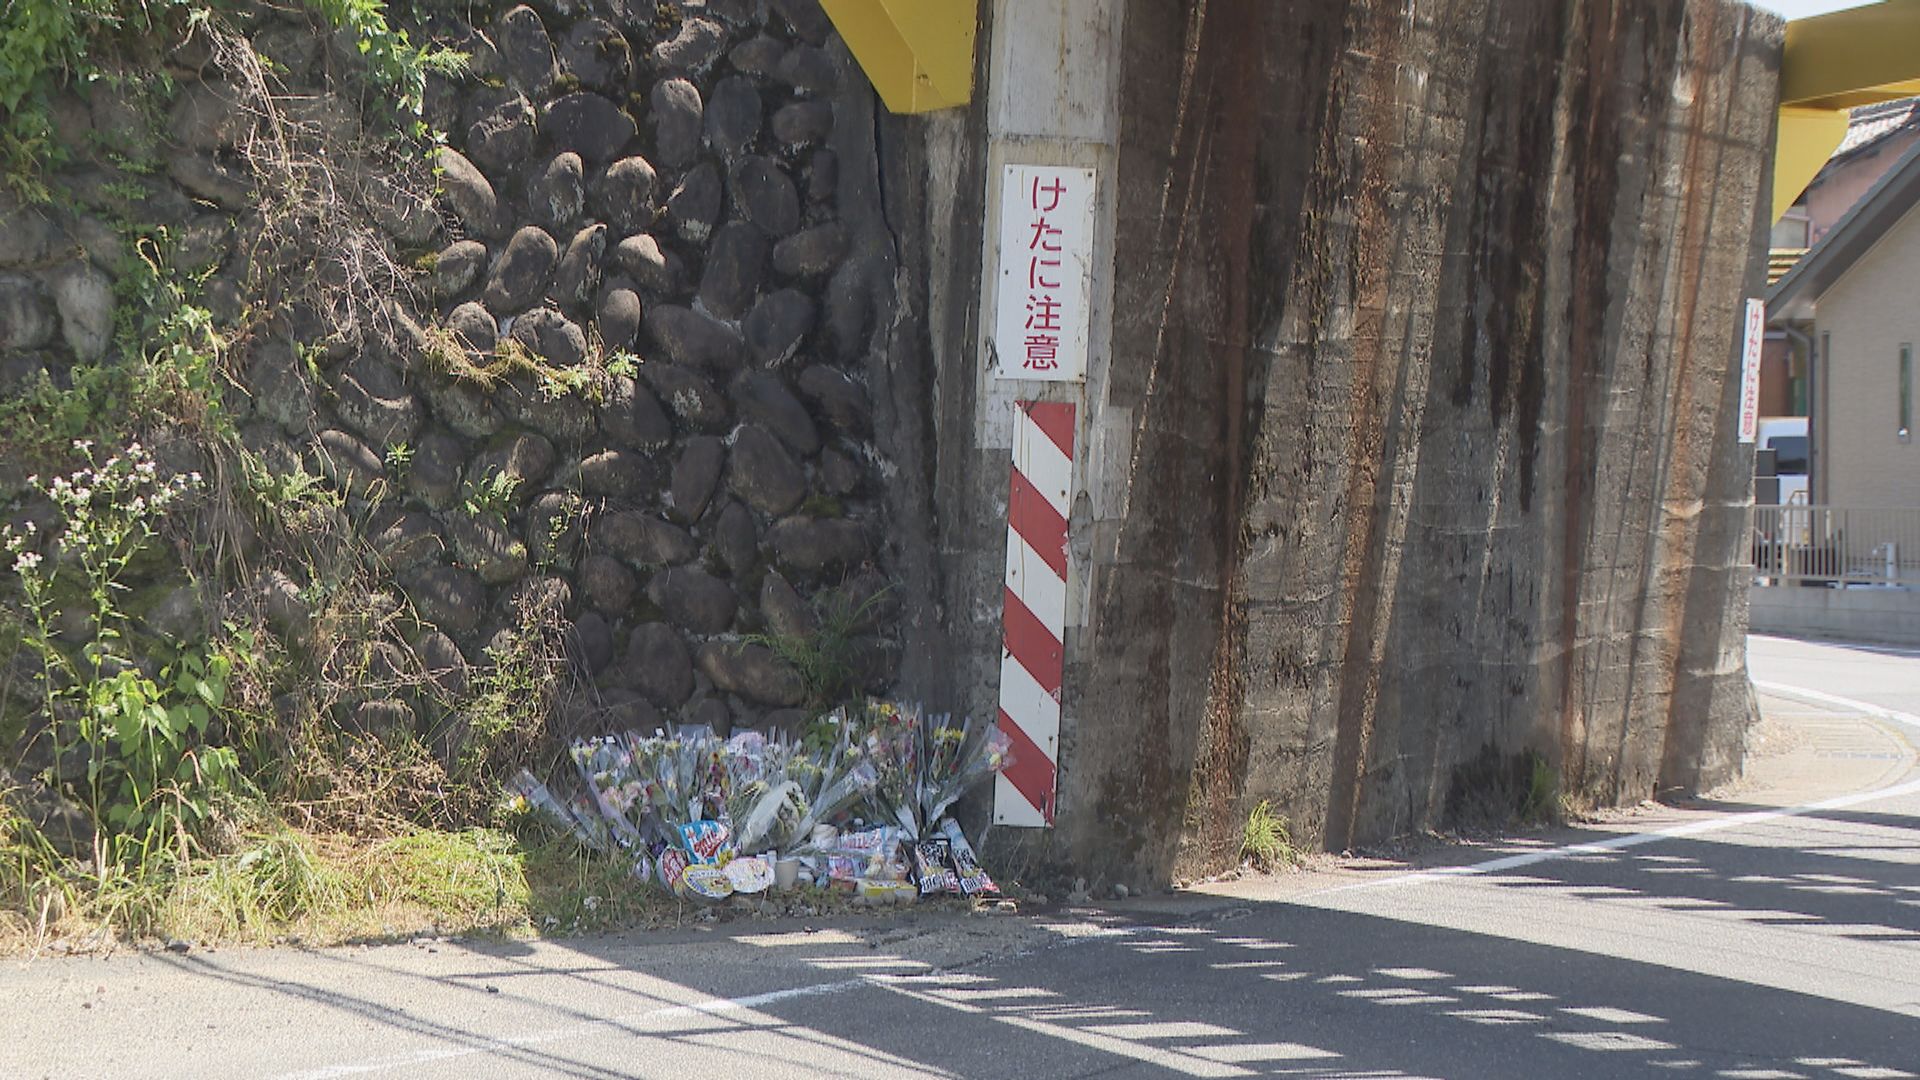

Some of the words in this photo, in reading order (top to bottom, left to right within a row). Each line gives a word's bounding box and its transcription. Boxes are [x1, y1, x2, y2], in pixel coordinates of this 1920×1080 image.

[1022, 175, 1067, 371] けたに注意
